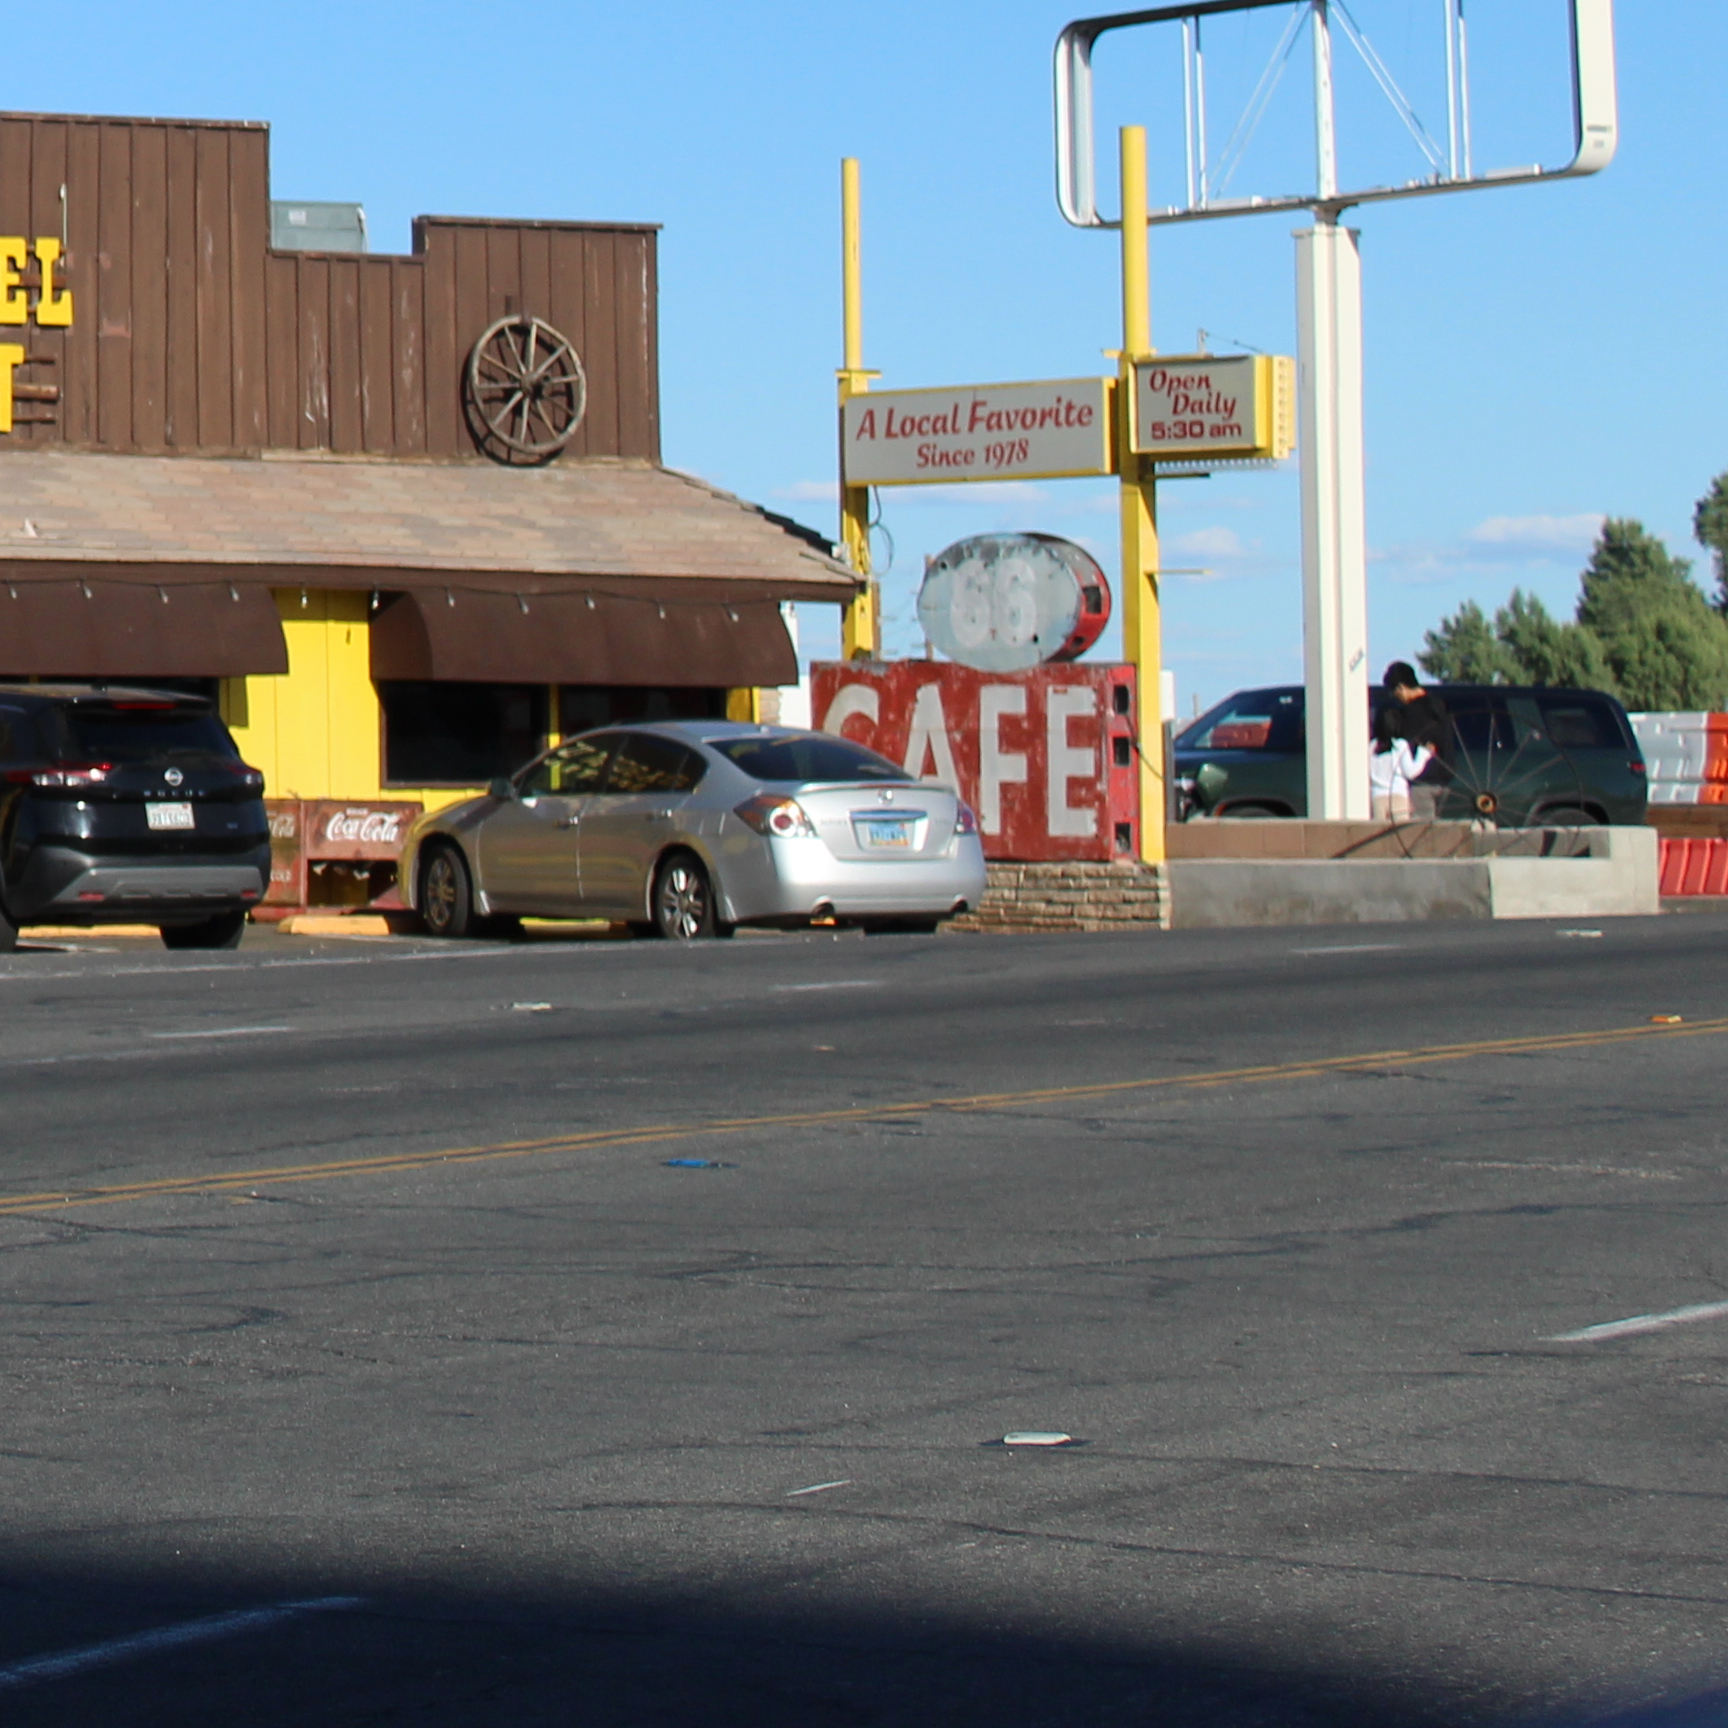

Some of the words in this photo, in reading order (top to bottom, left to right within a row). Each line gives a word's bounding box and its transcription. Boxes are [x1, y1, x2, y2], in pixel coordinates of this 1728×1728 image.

[1149, 368, 1211, 398] Open
[856, 408, 877, 441] A
[884, 402, 961, 440] Local
[967, 395, 1093, 434] Favorite
[1172, 390, 1237, 421] Daily
[1150, 420, 1205, 440] 5:30
[1209, 423, 1242, 438] am
[916, 442, 975, 468] Since
[983, 438, 1029, 468] 1978
